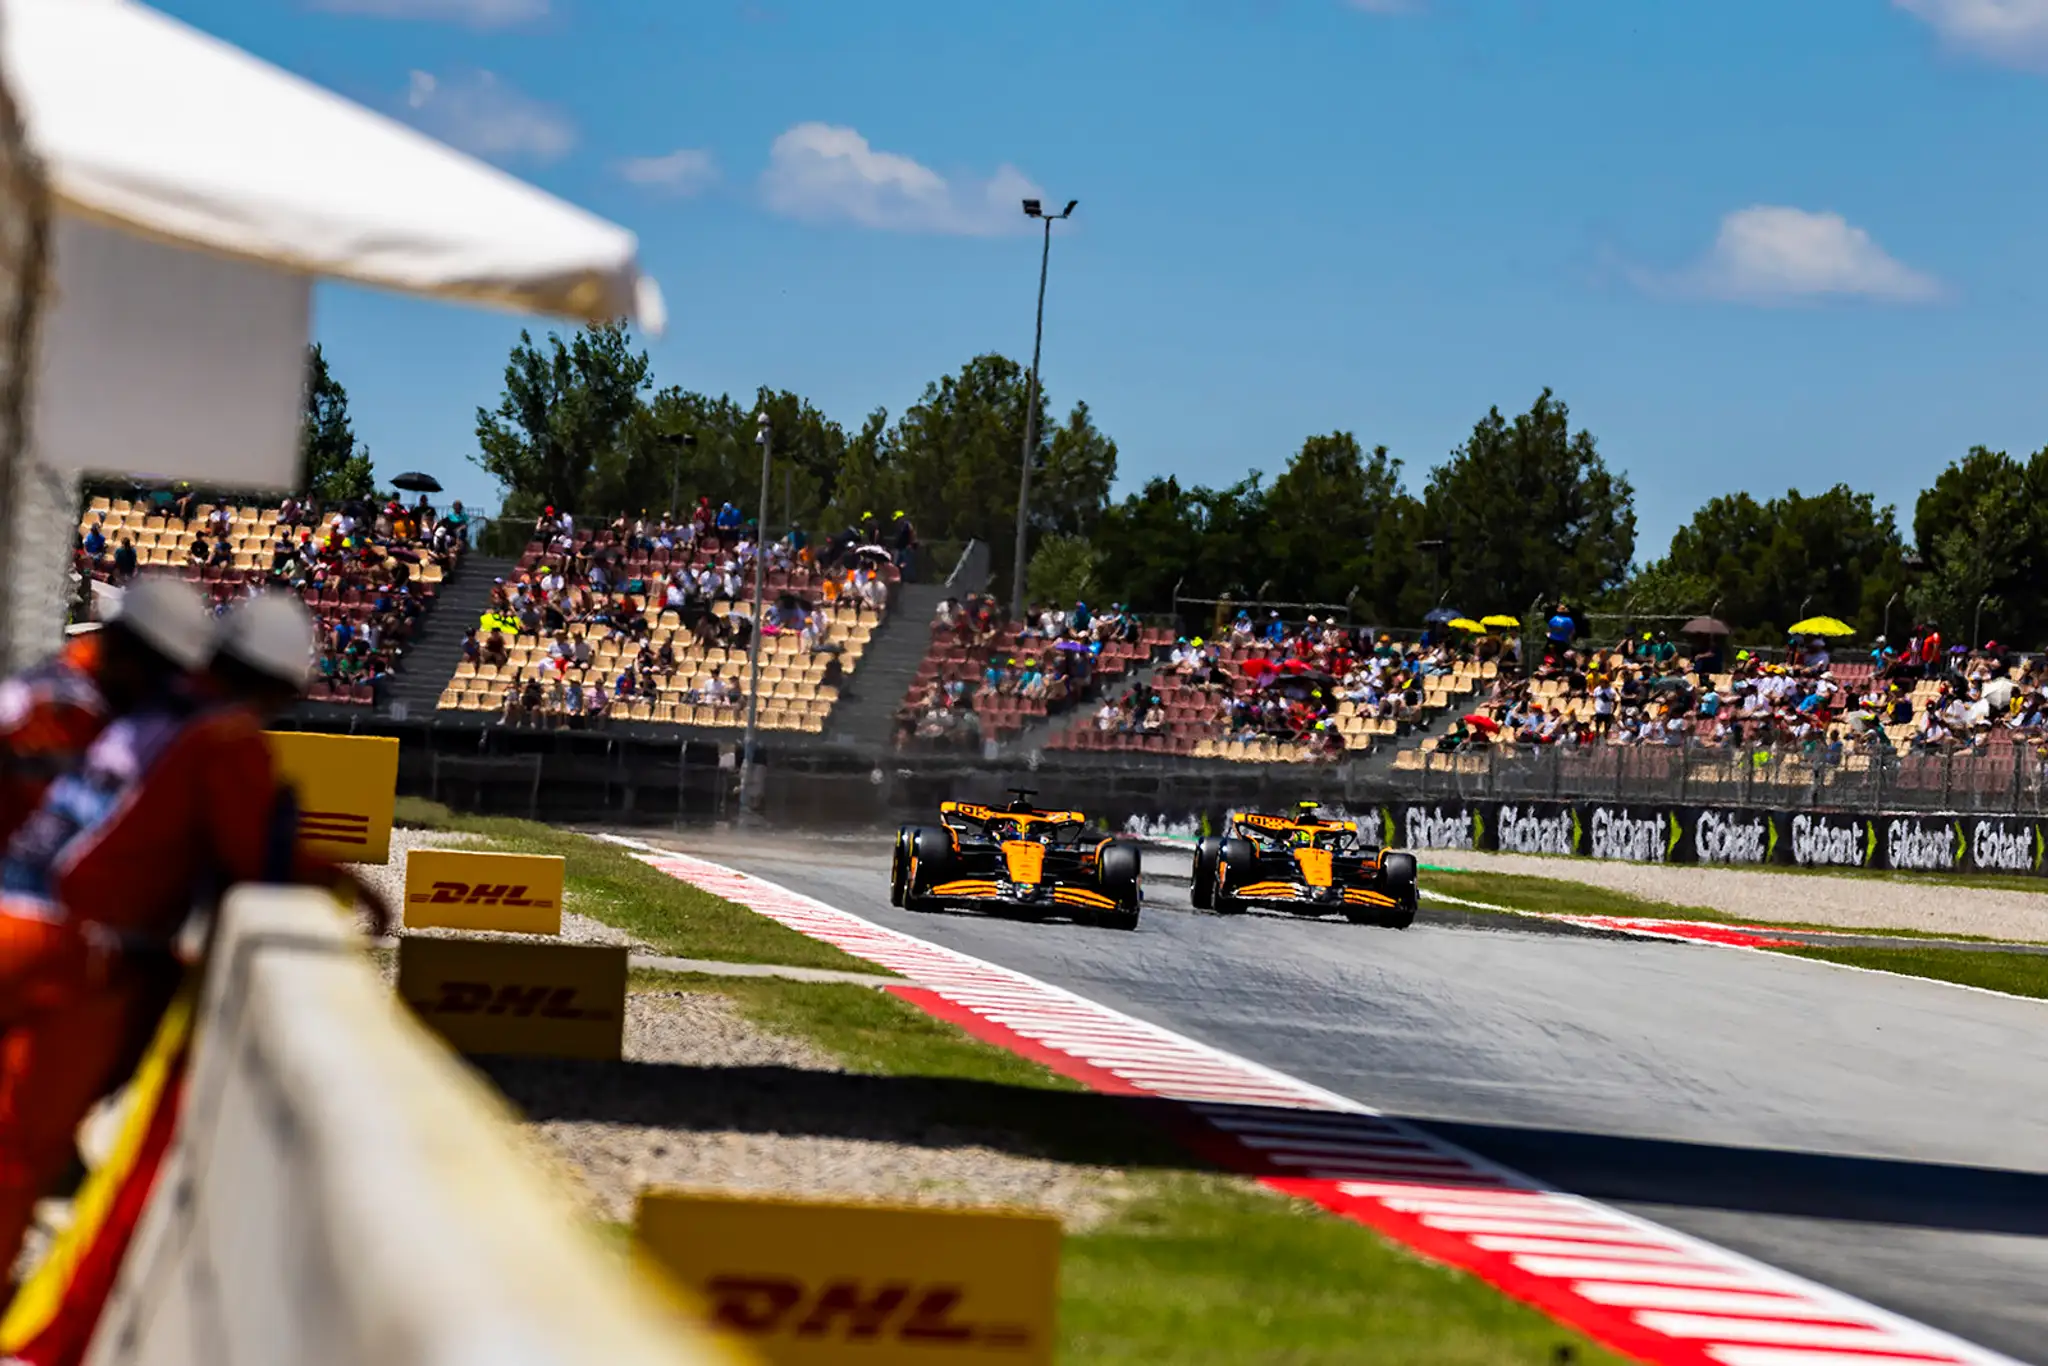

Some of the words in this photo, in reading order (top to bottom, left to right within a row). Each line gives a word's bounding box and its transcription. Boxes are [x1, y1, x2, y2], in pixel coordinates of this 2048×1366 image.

[430, 881, 533, 908] DHL
[433, 981, 584, 1020] DHL
[704, 1273, 973, 1346] DHL
